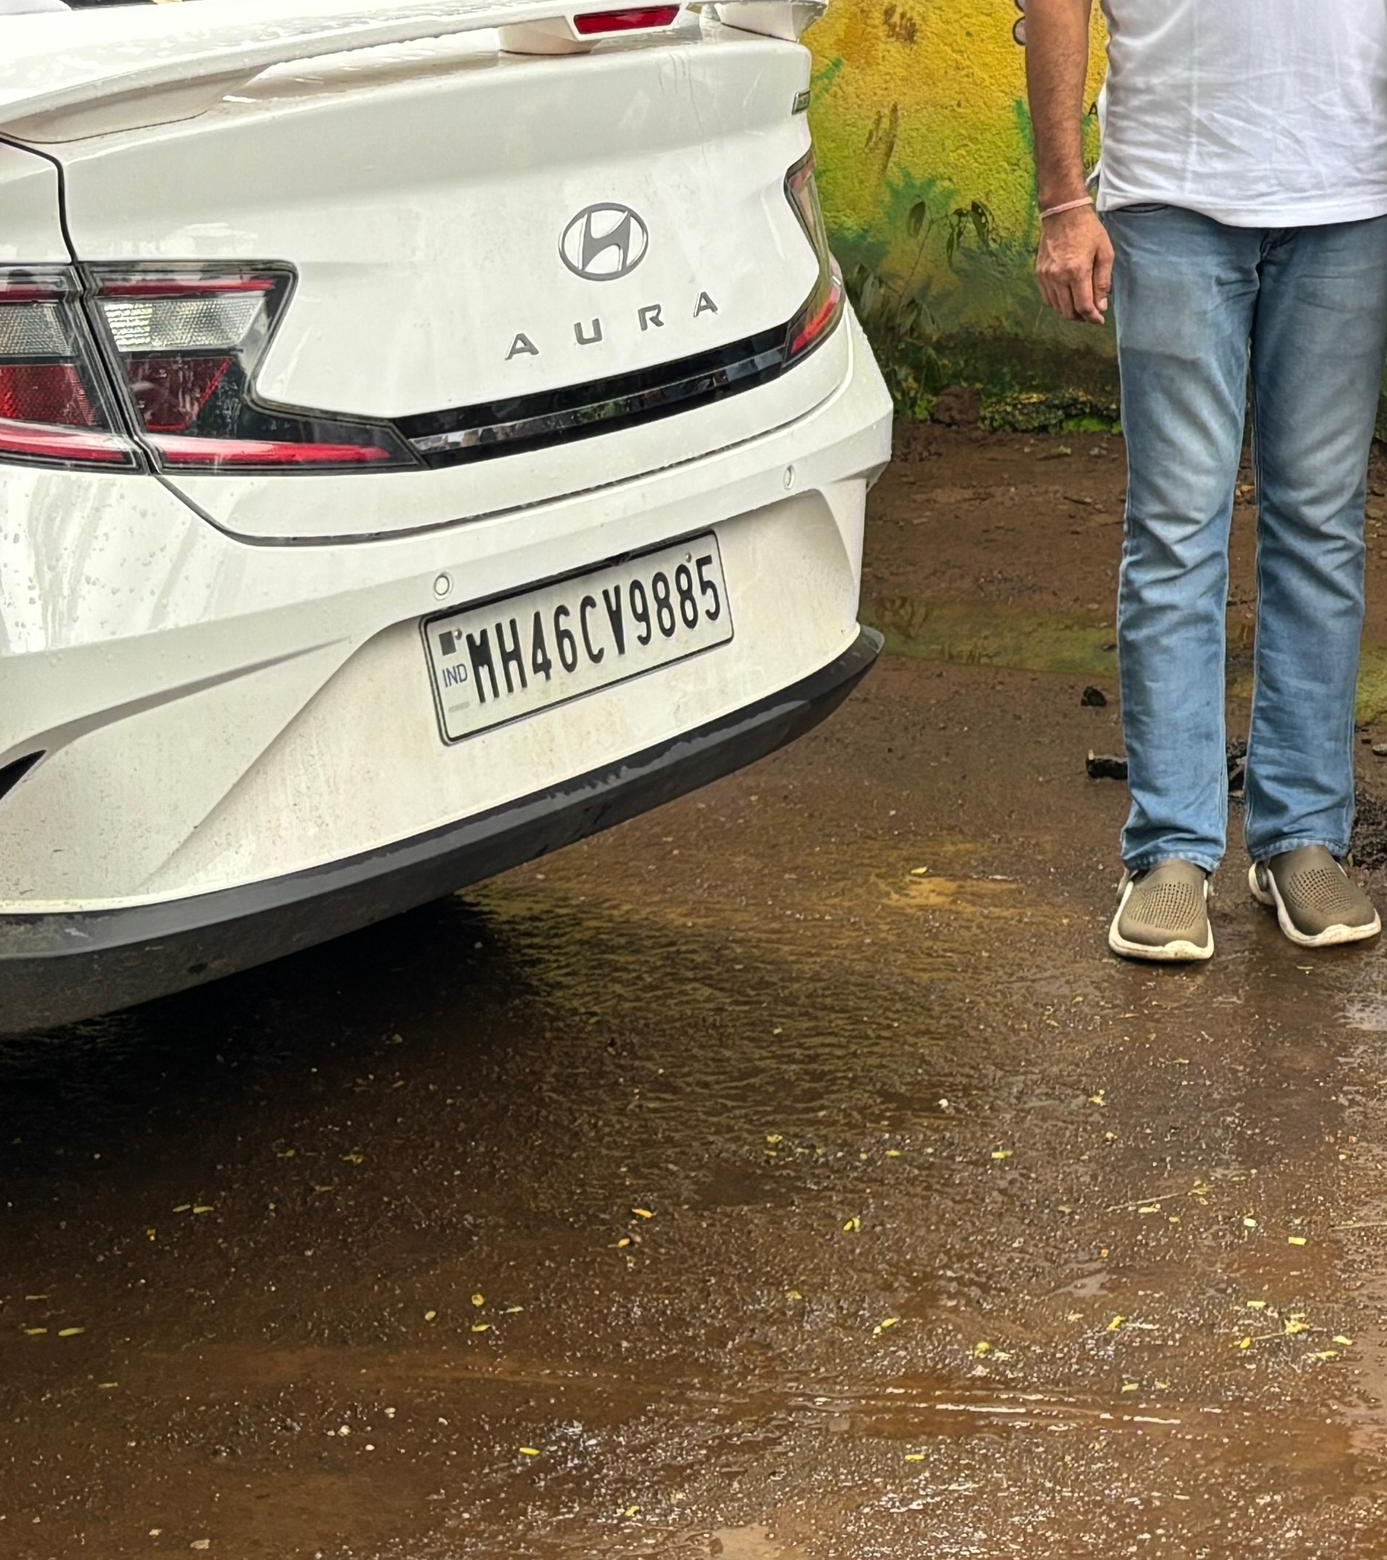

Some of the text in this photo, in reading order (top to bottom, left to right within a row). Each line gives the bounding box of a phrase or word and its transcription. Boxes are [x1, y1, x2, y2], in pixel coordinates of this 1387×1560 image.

[504, 290, 719, 362] AURA
[442, 553, 722, 705] IND MH46CV9885
